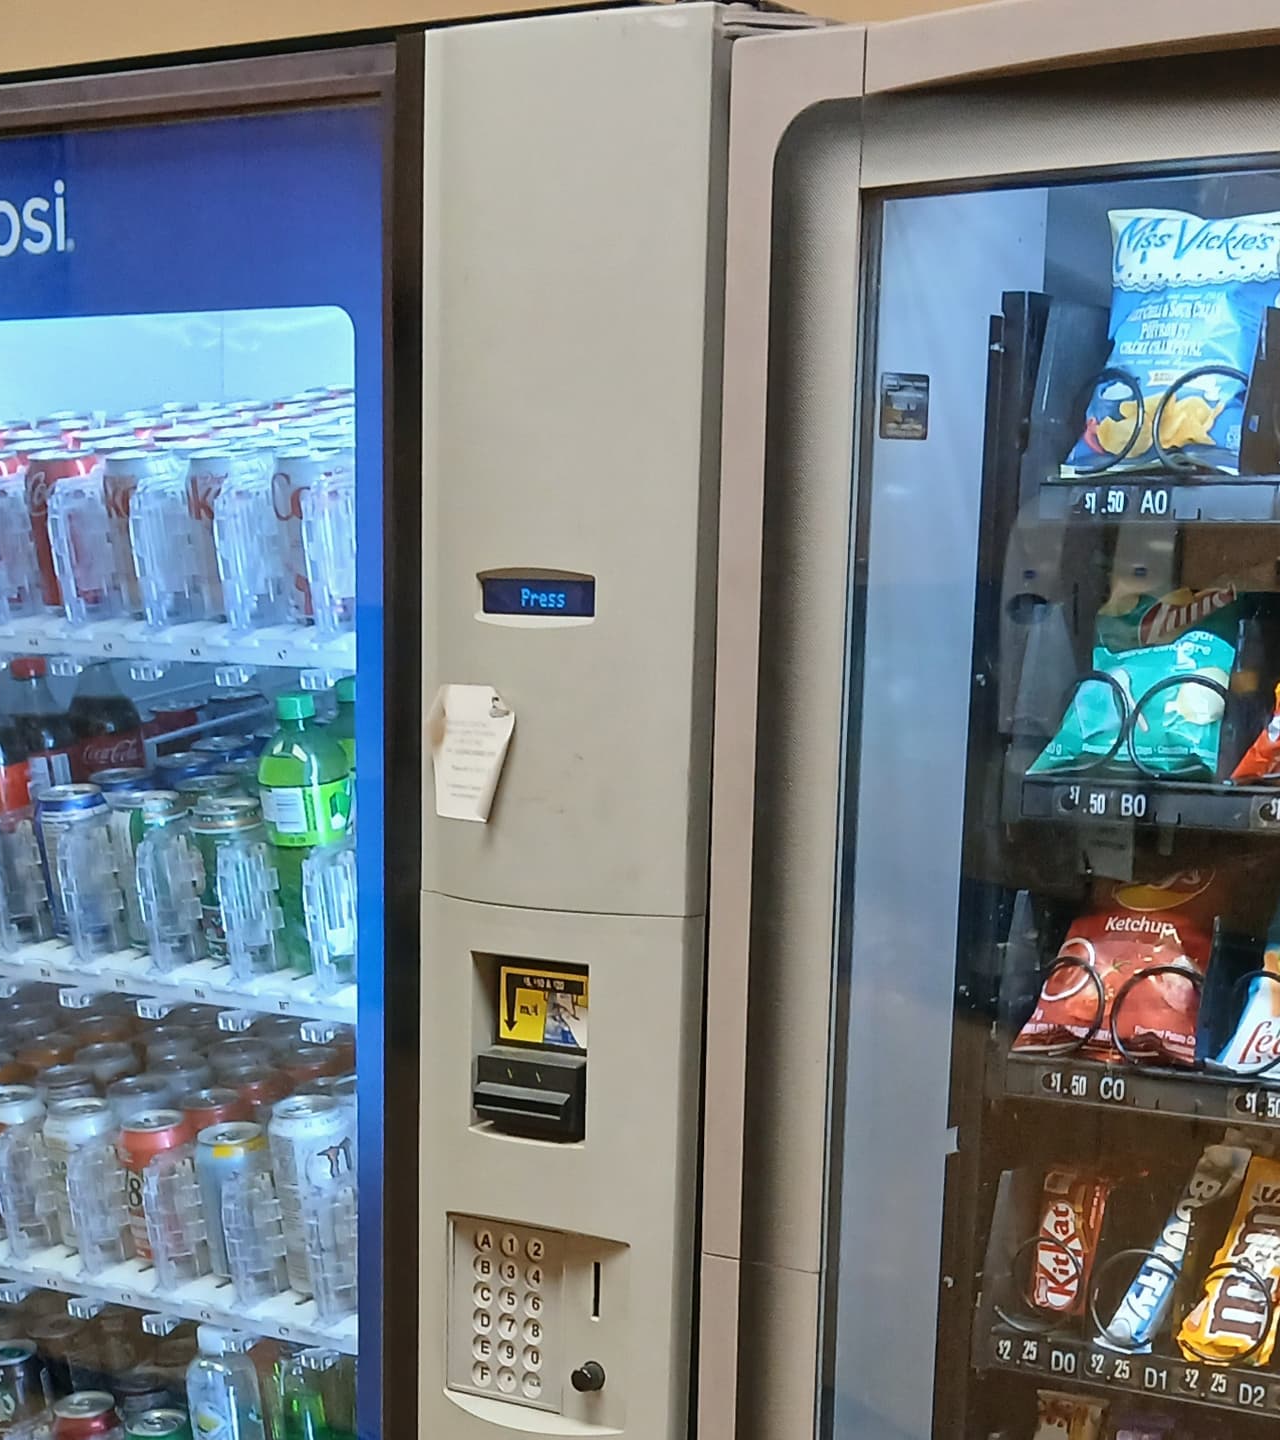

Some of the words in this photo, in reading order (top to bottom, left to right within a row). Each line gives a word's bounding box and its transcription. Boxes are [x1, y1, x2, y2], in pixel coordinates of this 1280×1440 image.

[1174, 218, 1275, 262] Vickie's
[1141, 489, 1168, 515] A0
[521, 588, 566, 608] Press
[1121, 794, 1146, 817] B0
[1105, 916, 1174, 938] Ketchup
[1100, 1078, 1126, 1100] C0
[1051, 1351, 1076, 1373] D0
[1144, 1367, 1167, 1390] D1
[1239, 1383, 1265, 1407] D2
